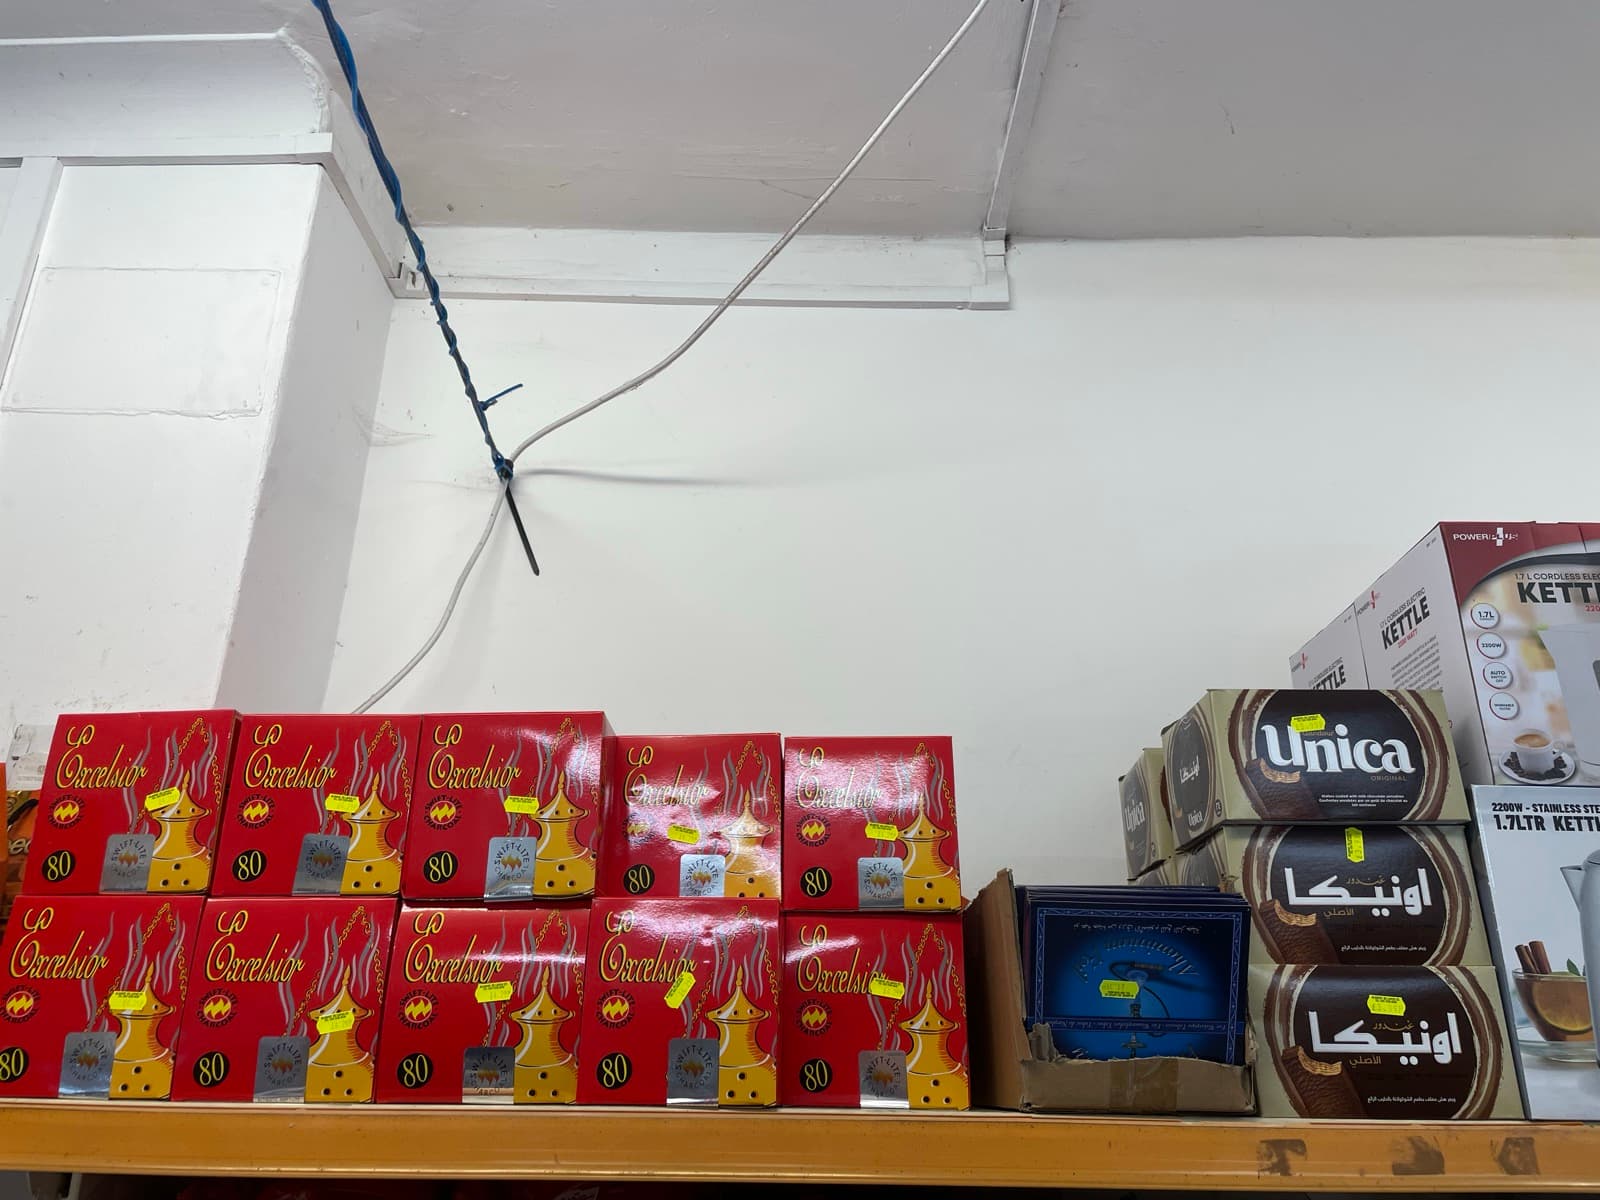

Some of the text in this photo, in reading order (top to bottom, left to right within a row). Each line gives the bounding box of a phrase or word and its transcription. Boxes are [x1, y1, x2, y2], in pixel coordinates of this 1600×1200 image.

[1533, 573, 1580, 581] CORDLESS
[1382, 596, 1430, 650] KETTLE
[55, 724, 148, 789] Excelsior
[244, 724, 337, 789] Excelsior
[428, 723, 522, 789] Excelsior
[1260, 724, 1416, 774] Unica
[1491, 802, 1523, 812] 2200W
[1532, 803, 1581, 814] STAINLESS
[1493, 814, 1546, 831] 1.7LTR
[47, 851, 71, 881] 80
[238, 850, 262, 881] 80
[428, 852, 453, 882] 80
[628, 865, 650, 894] 80
[804, 867, 828, 896] 80
[10, 906, 109, 980] Excelsior
[205, 910, 304, 983] Excelsior
[404, 911, 504, 984] Excelsior
[0, 1048, 24, 1081] 80
[199, 1052, 225, 1086] 80
[402, 1054, 429, 1088] 80
[602, 1054, 628, 1088] 80
[804, 1059, 828, 1092] 80
